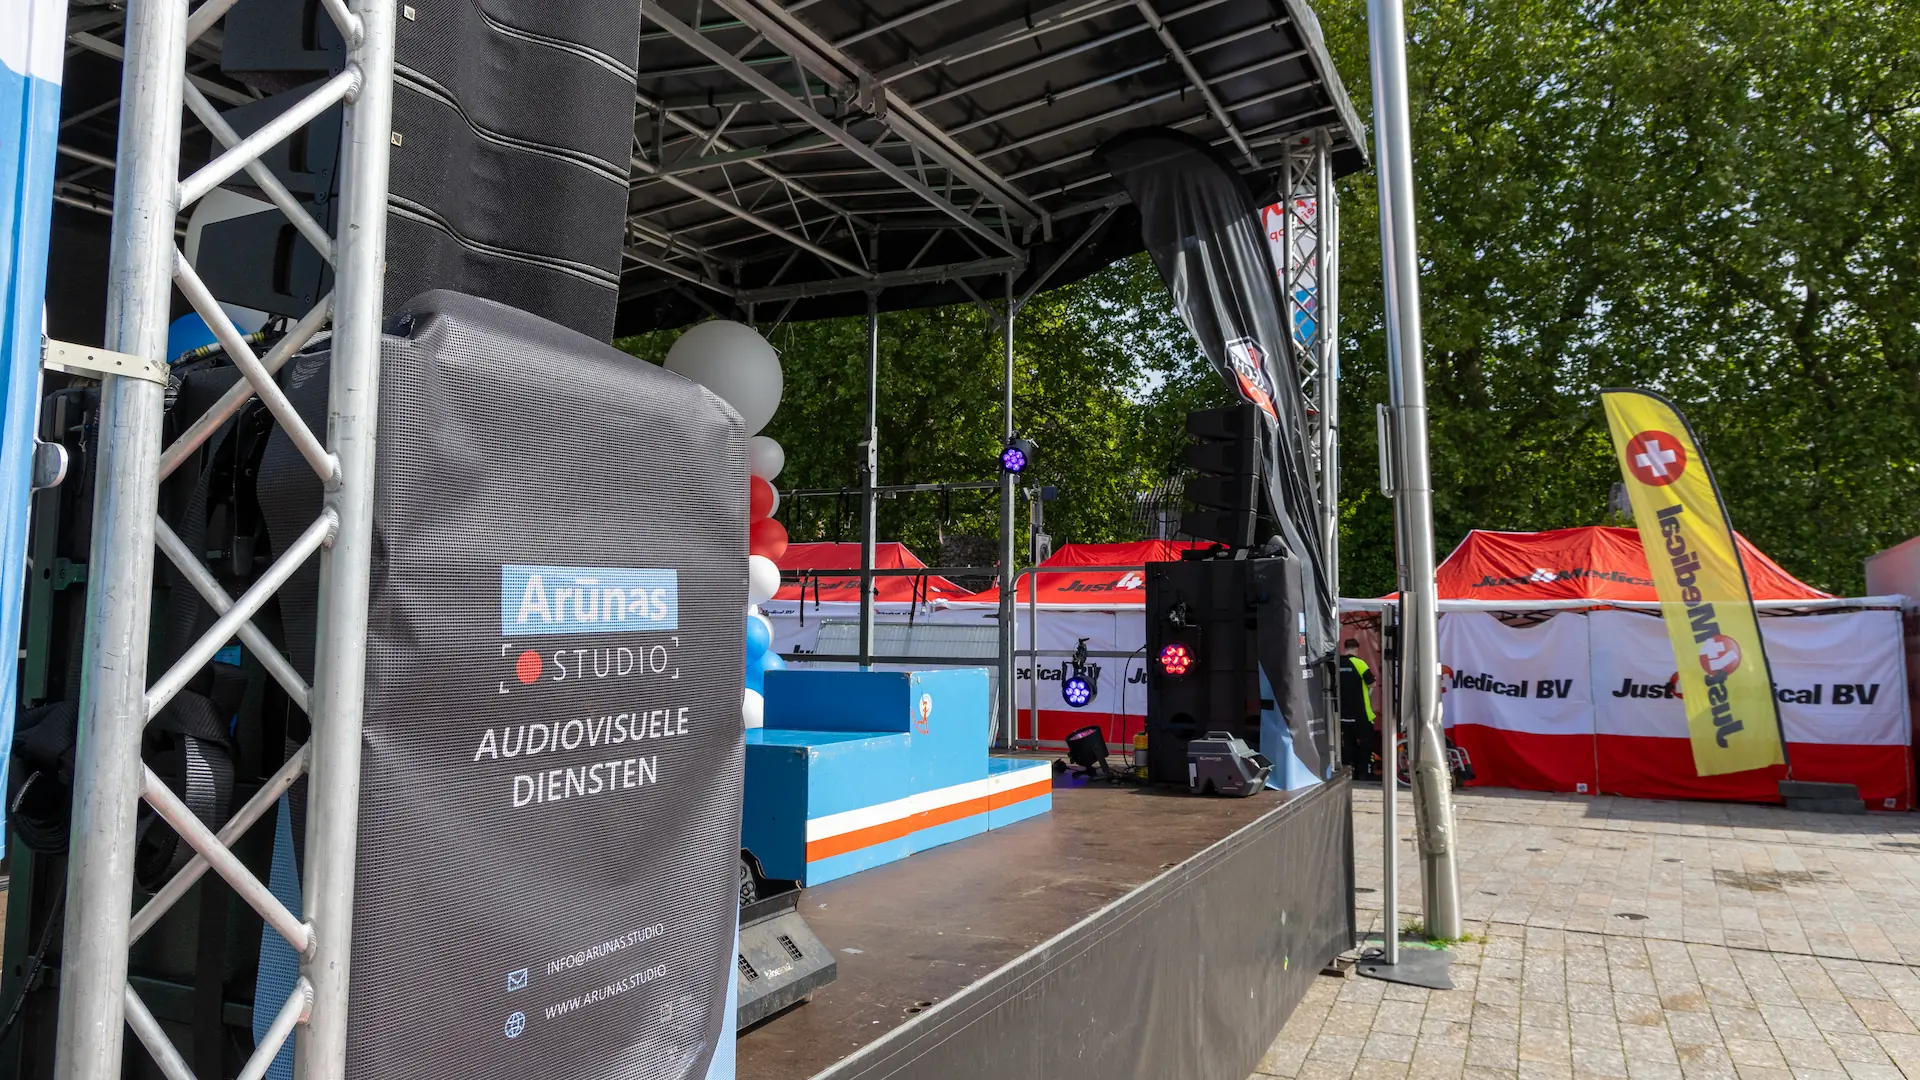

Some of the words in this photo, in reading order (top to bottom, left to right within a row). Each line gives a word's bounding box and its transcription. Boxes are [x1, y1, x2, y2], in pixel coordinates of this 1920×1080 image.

[517, 575, 667, 624] Arūnas
[553, 645, 667, 680] STUDIO
[1535, 679, 1573, 699] BV
[1832, 684, 1880, 705] BV
[474, 707, 689, 761] AUDIOVISUELE
[513, 756, 657, 807] DIENSTEN
[547, 923, 664, 975] INFO@ARUNAS.STUDIO
[545, 965, 667, 1019] WWW.ARUNAS.STUDIO
